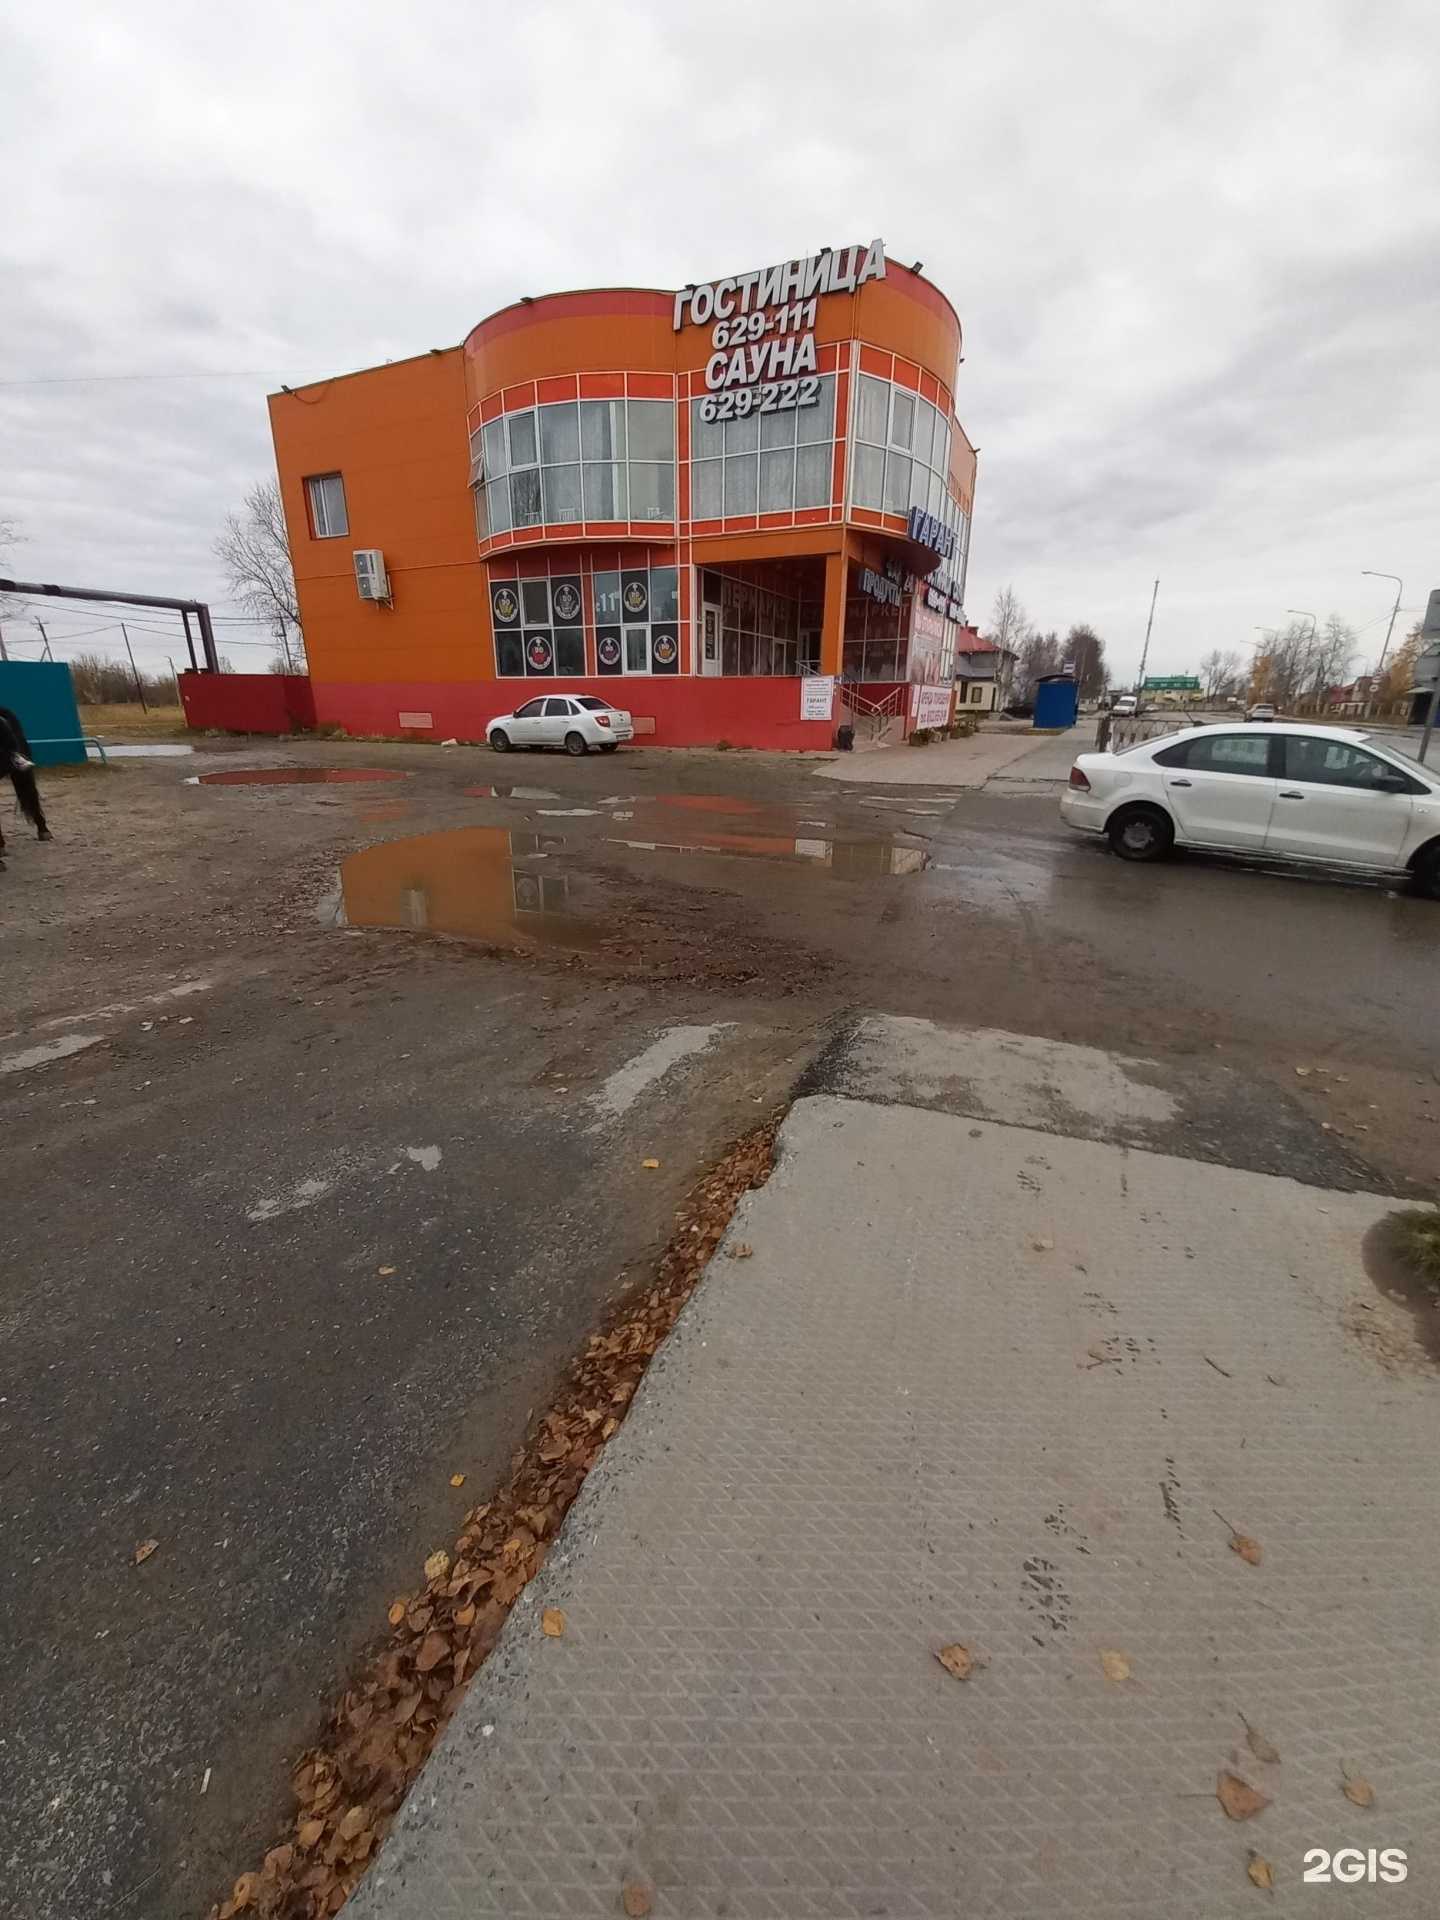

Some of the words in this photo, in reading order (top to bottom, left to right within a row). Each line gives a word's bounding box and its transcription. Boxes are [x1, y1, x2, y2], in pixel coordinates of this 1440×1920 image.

[673, 238, 887, 331] ГОСТИНИЦА
[711, 298, 818, 350] 629-111
[704, 332, 818, 390] САУНА
[698, 376, 820, 423] 629-222
